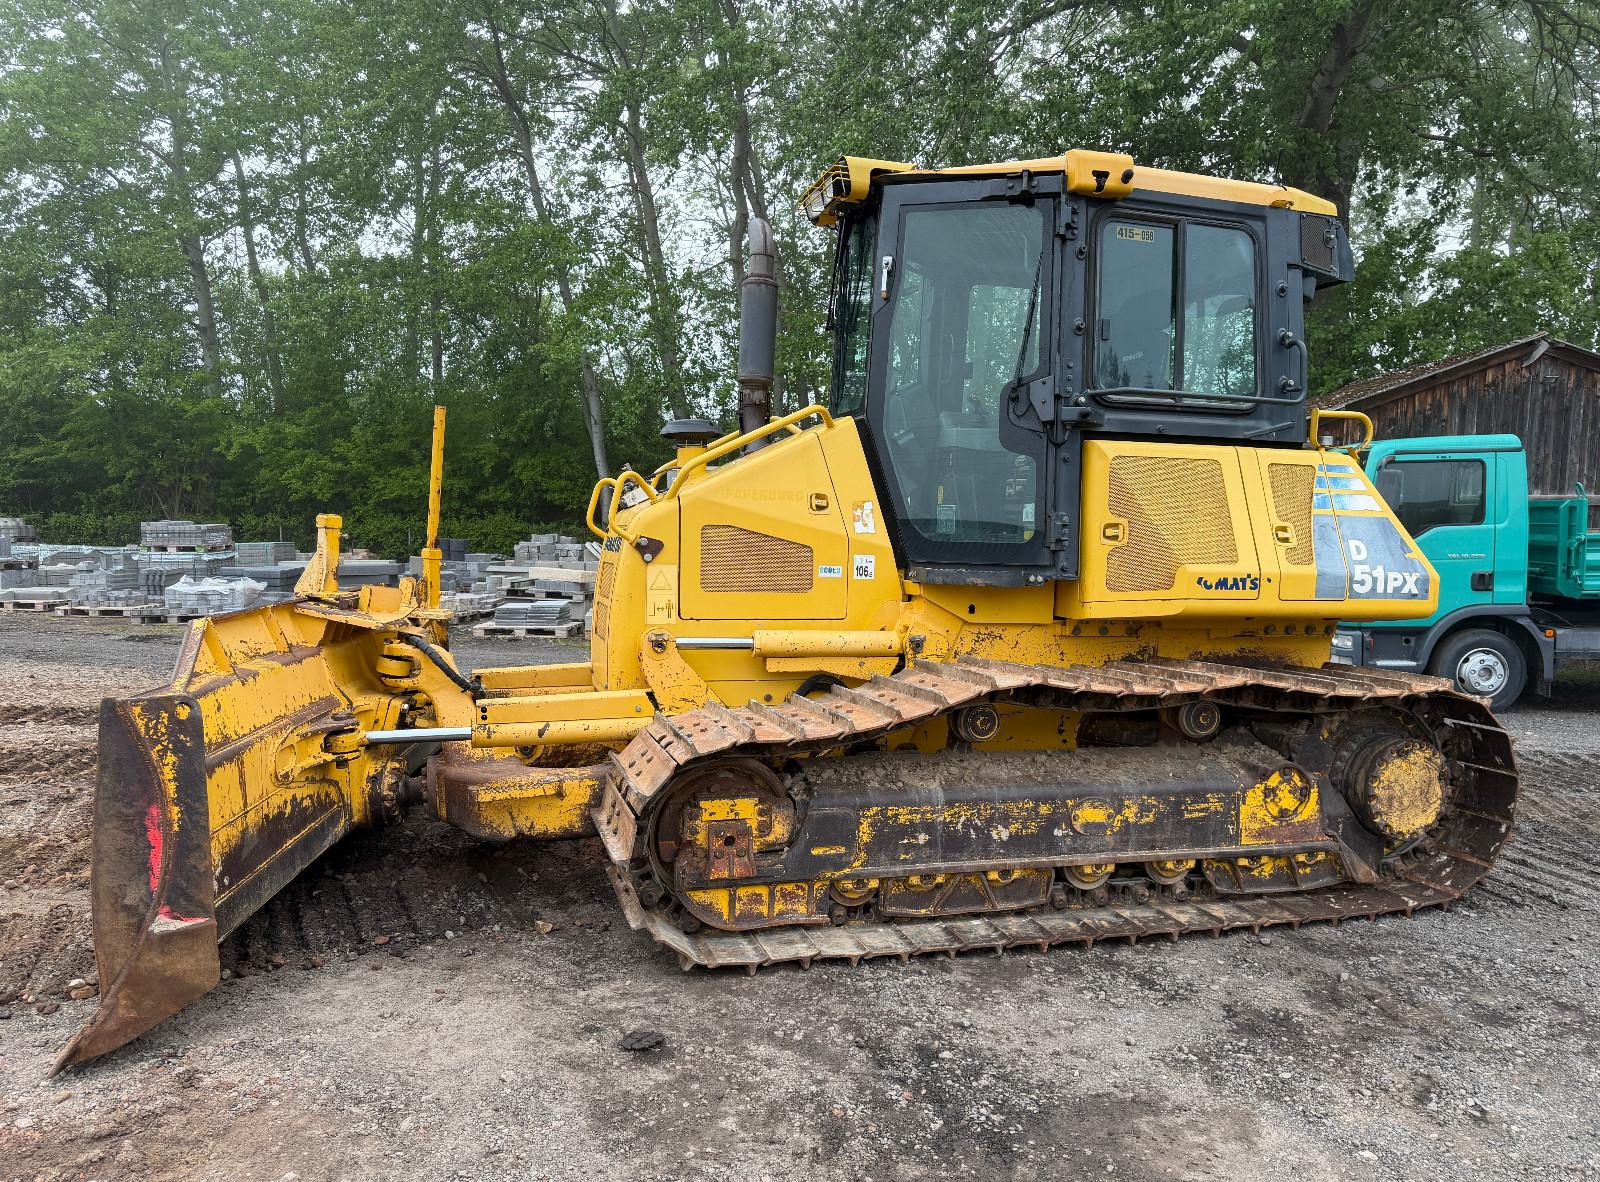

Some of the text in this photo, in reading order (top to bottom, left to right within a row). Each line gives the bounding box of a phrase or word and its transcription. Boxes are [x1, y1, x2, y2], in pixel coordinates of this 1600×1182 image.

[1348, 539, 1368, 561] D
[855, 565, 869, 577] 106
[1352, 564, 1420, 594] 51PX
[1196, 573, 1272, 591] OMATS
